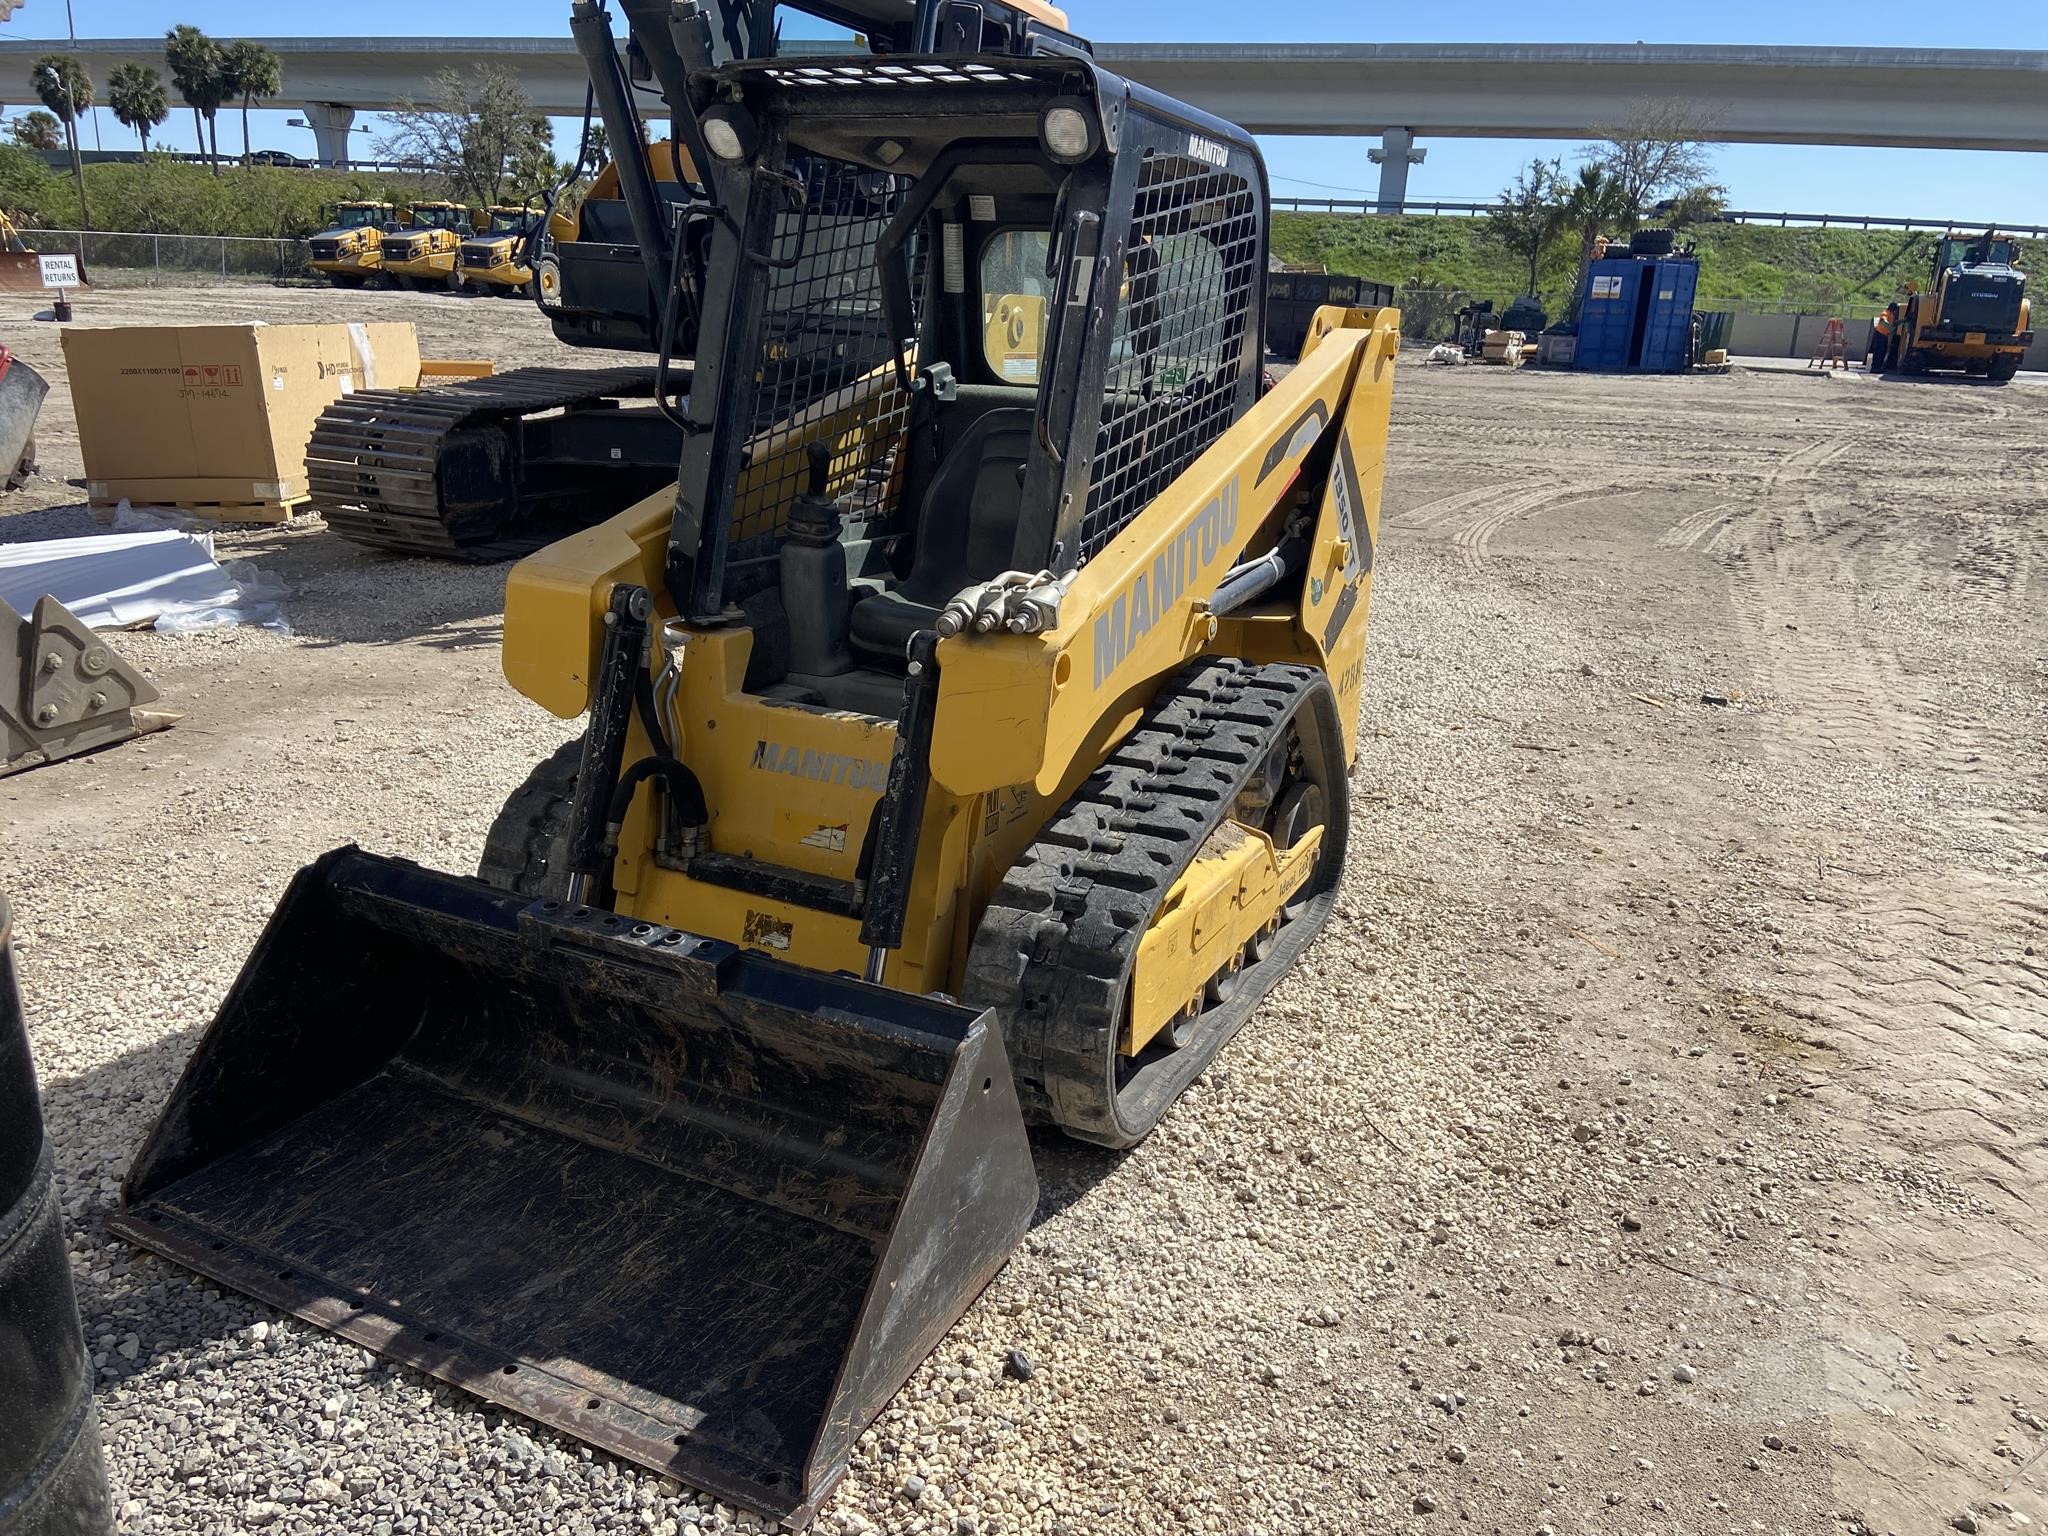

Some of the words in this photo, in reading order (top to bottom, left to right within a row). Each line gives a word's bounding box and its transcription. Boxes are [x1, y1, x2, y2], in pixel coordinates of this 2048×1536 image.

[1188, 133, 1229, 168] MANITOU
[45, 260, 72, 270] RENTAL
[45, 272, 76, 282] RETURNS
[1093, 474, 1240, 692] MANITOU
[749, 740, 888, 792] MANITOU
